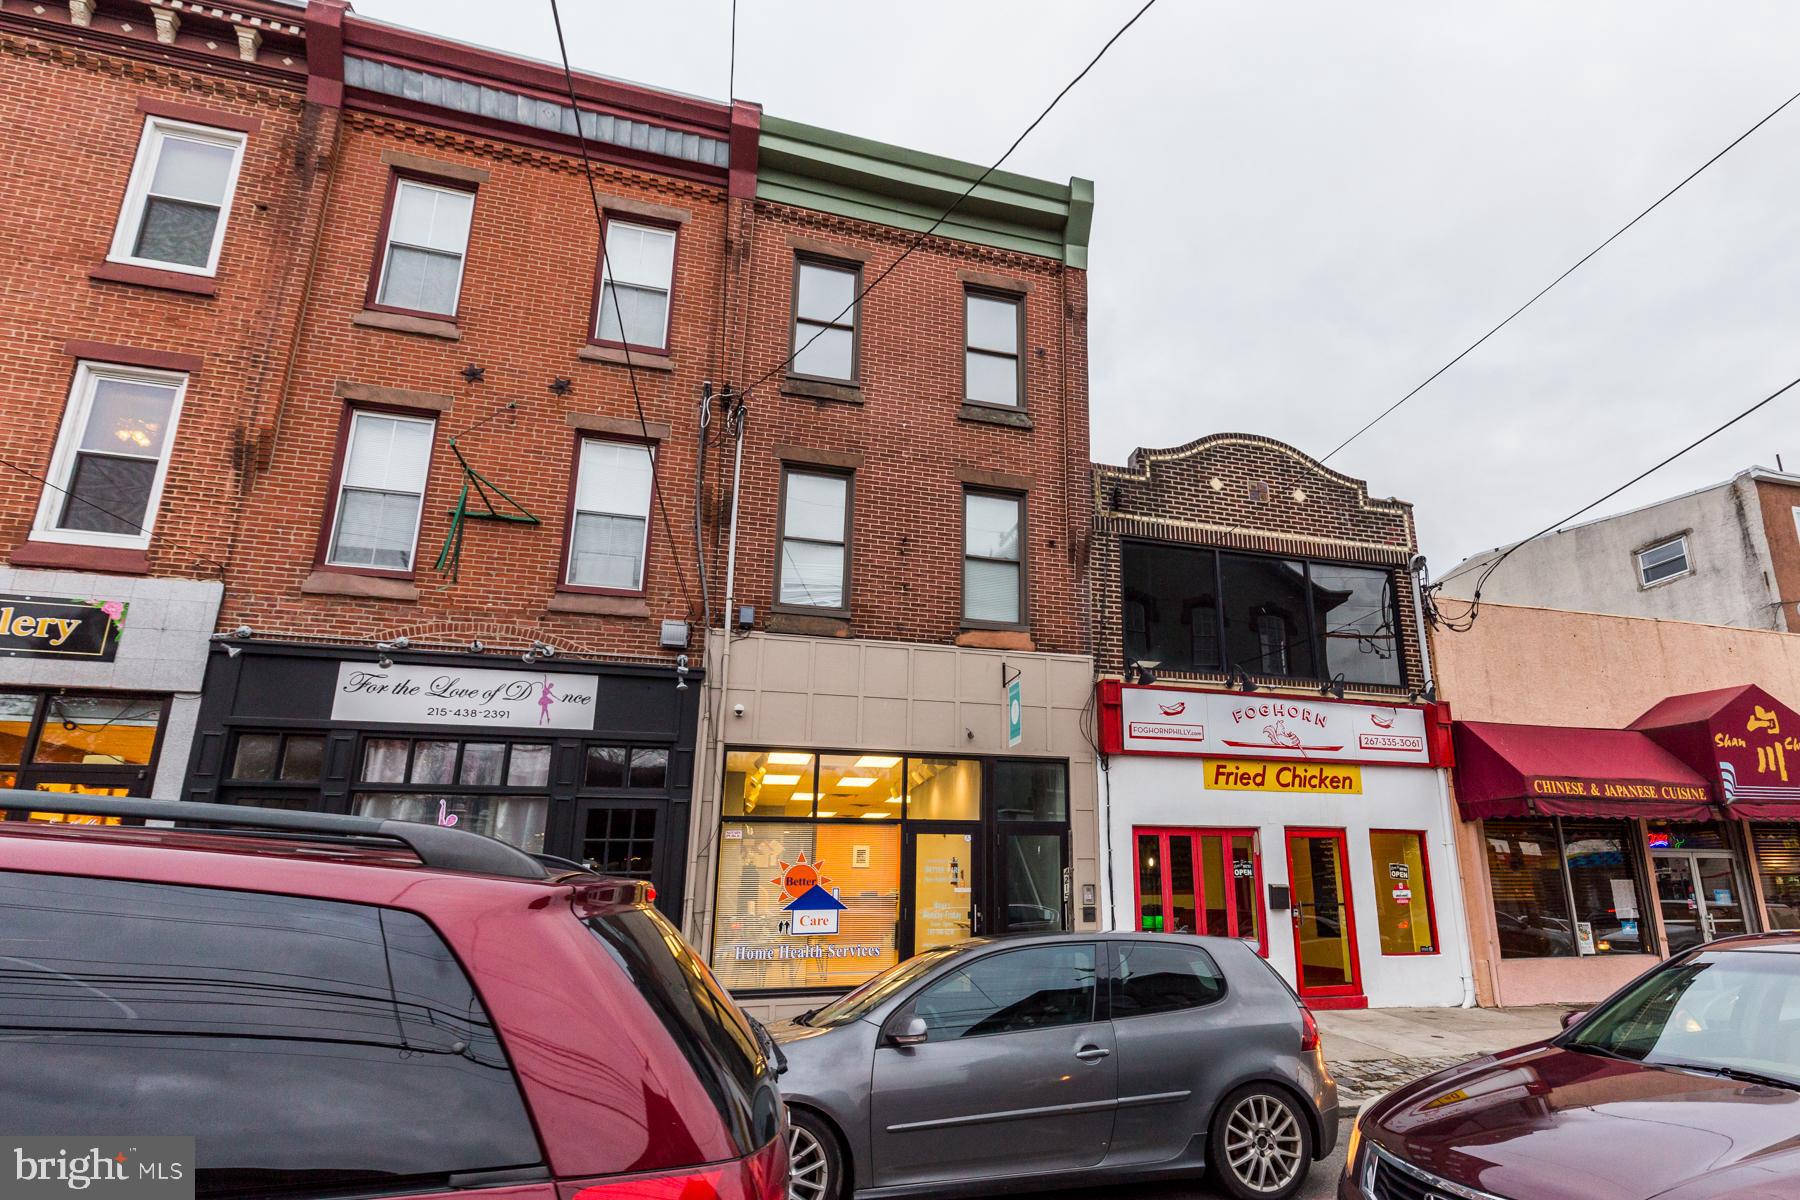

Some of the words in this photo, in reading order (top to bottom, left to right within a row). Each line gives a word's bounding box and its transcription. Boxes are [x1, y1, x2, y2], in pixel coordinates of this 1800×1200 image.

[0, 607, 82, 645] lery
[343, 671, 389, 694] For
[391, 679, 420, 696] the
[424, 675, 479, 700] Love
[478, 683, 504, 706] of
[426, 707, 510, 719] 215-438-2391
[1231, 703, 1328, 728] FOGHORN
[1133, 726, 1202, 737] FOGHORNPHILLY.com
[1364, 736, 1420, 748] 267-335-3061
[1714, 732, 1746, 748] Shan
[1213, 763, 1266, 788] Fried
[1275, 765, 1353, 790] Chicken
[1533, 779, 1586, 796] CHINESE
[1590, 783, 1601, 797] &
[1605, 783, 1658, 799] JAPANESE
[1661, 786, 1707, 801] CUISINE
[1234, 868, 1252, 876] OPEN
[1391, 870, 1408, 878] OPEN
[785, 876, 817, 886] Better
[799, 914, 830, 927] Care
[734, 945, 774, 961] Home
[779, 943, 823, 959] Health
[827, 943, 881, 959] Services
